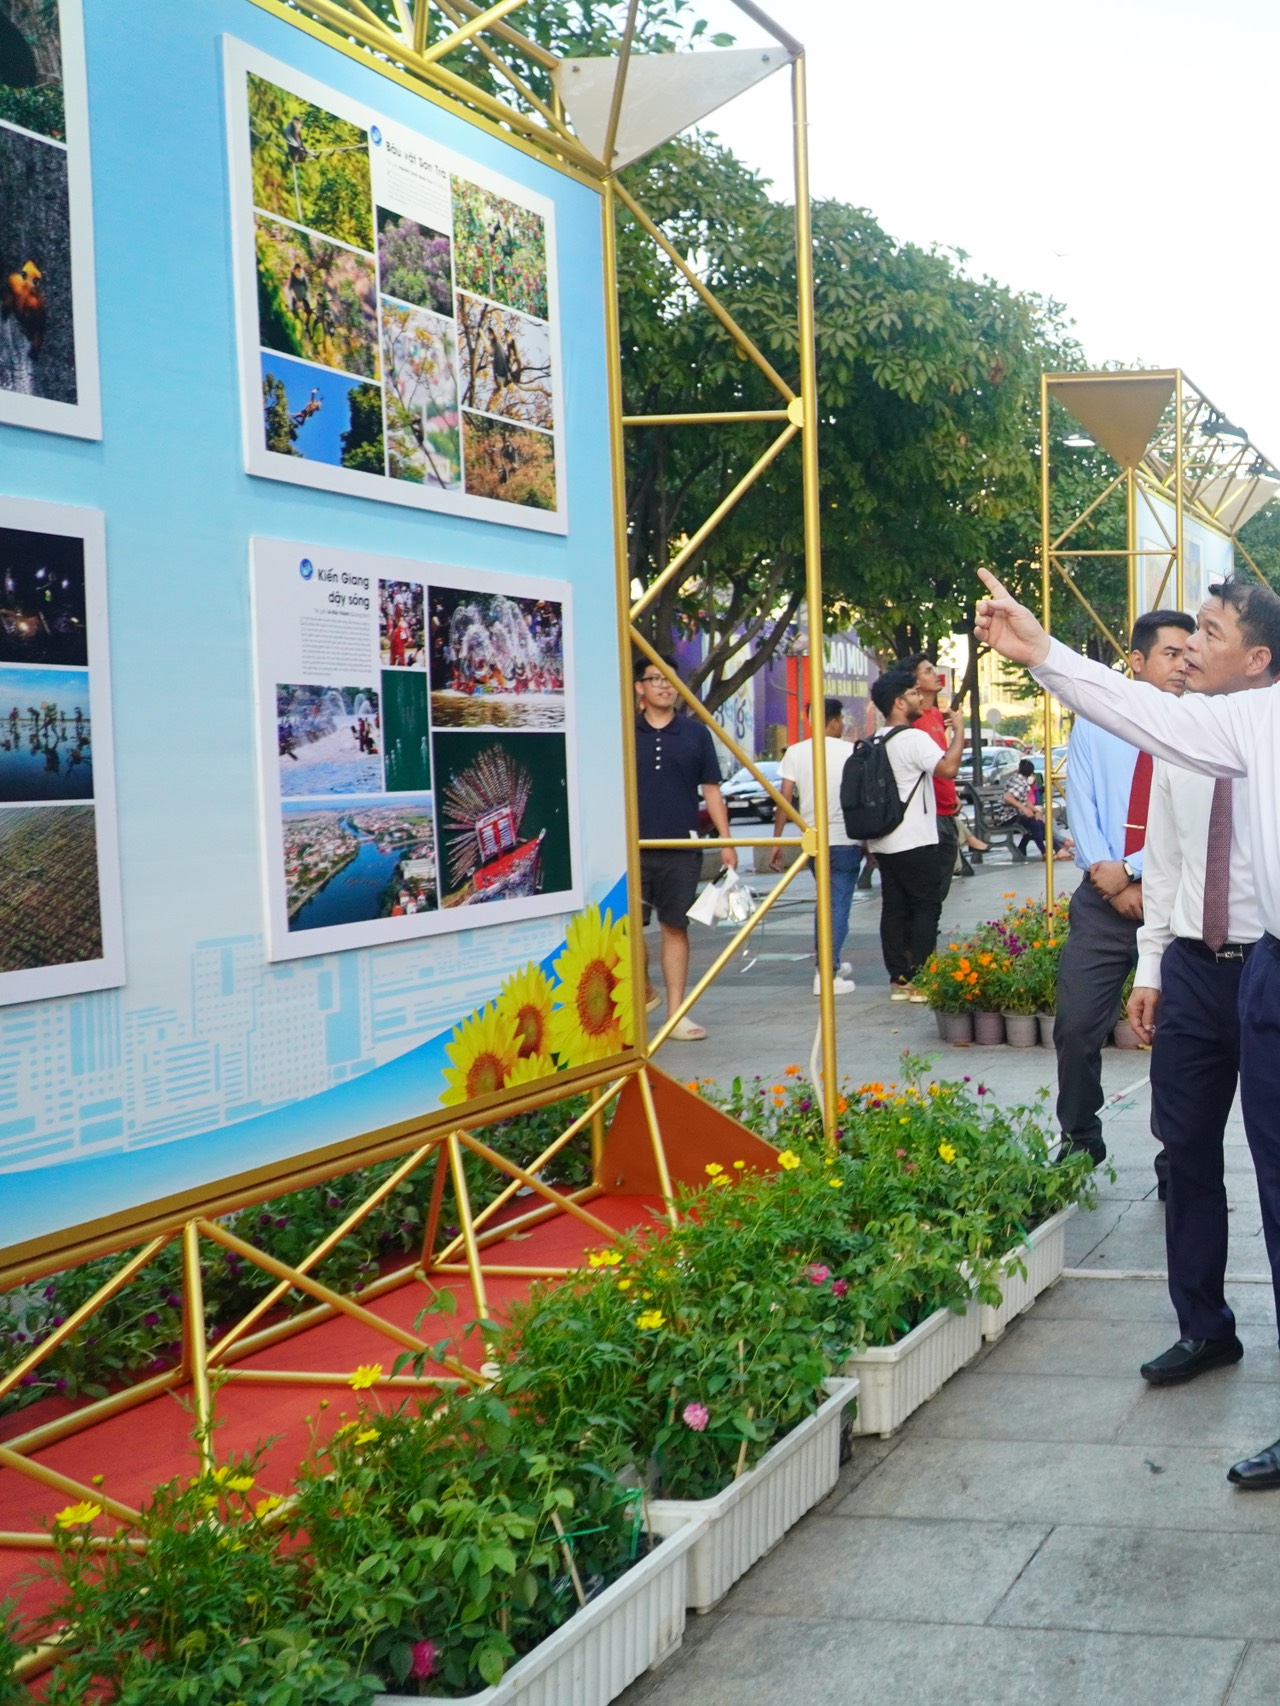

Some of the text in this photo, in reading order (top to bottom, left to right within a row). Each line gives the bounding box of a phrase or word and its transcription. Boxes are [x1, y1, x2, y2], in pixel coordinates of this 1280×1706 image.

[317, 567, 369, 590] Kiến Giang
[328, 590, 370, 610] dậy sóng
